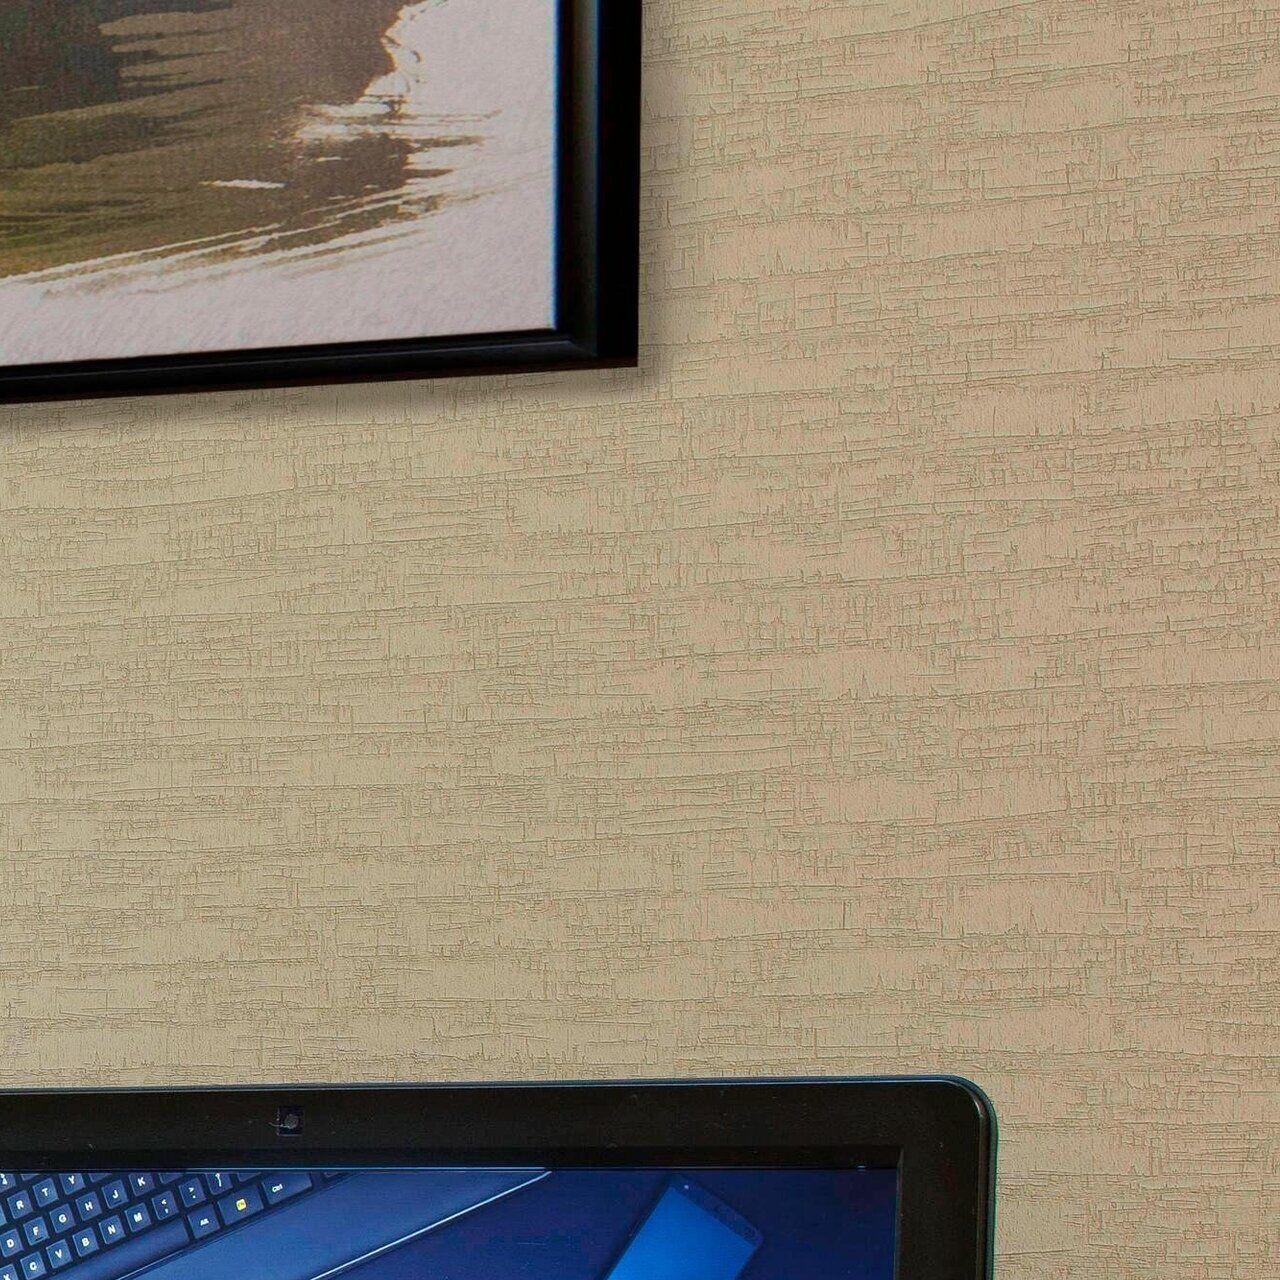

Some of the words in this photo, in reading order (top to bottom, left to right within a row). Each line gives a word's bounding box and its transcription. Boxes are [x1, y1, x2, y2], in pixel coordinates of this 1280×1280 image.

[1, 1178, 8, 1186] 4
[68, 1175, 76, 1185] Y
[138, 1177, 145, 1186] K
[42, 1188, 47, 1196] T
[113, 1190, 118, 1198] J
[17, 1201, 24, 1209] R
[85, 1202, 93, 1210] H
[59, 1214, 66, 1222] G
[134, 1213, 142, 1222] M
[33, 1227, 38, 1235] F
[108, 1225, 115, 1234] N
[7, 1239, 14, 1247] D
[82, 1238, 89, 1246] B
[55, 1249, 62, 1258] V
[30, 1262, 37, 1270] C
